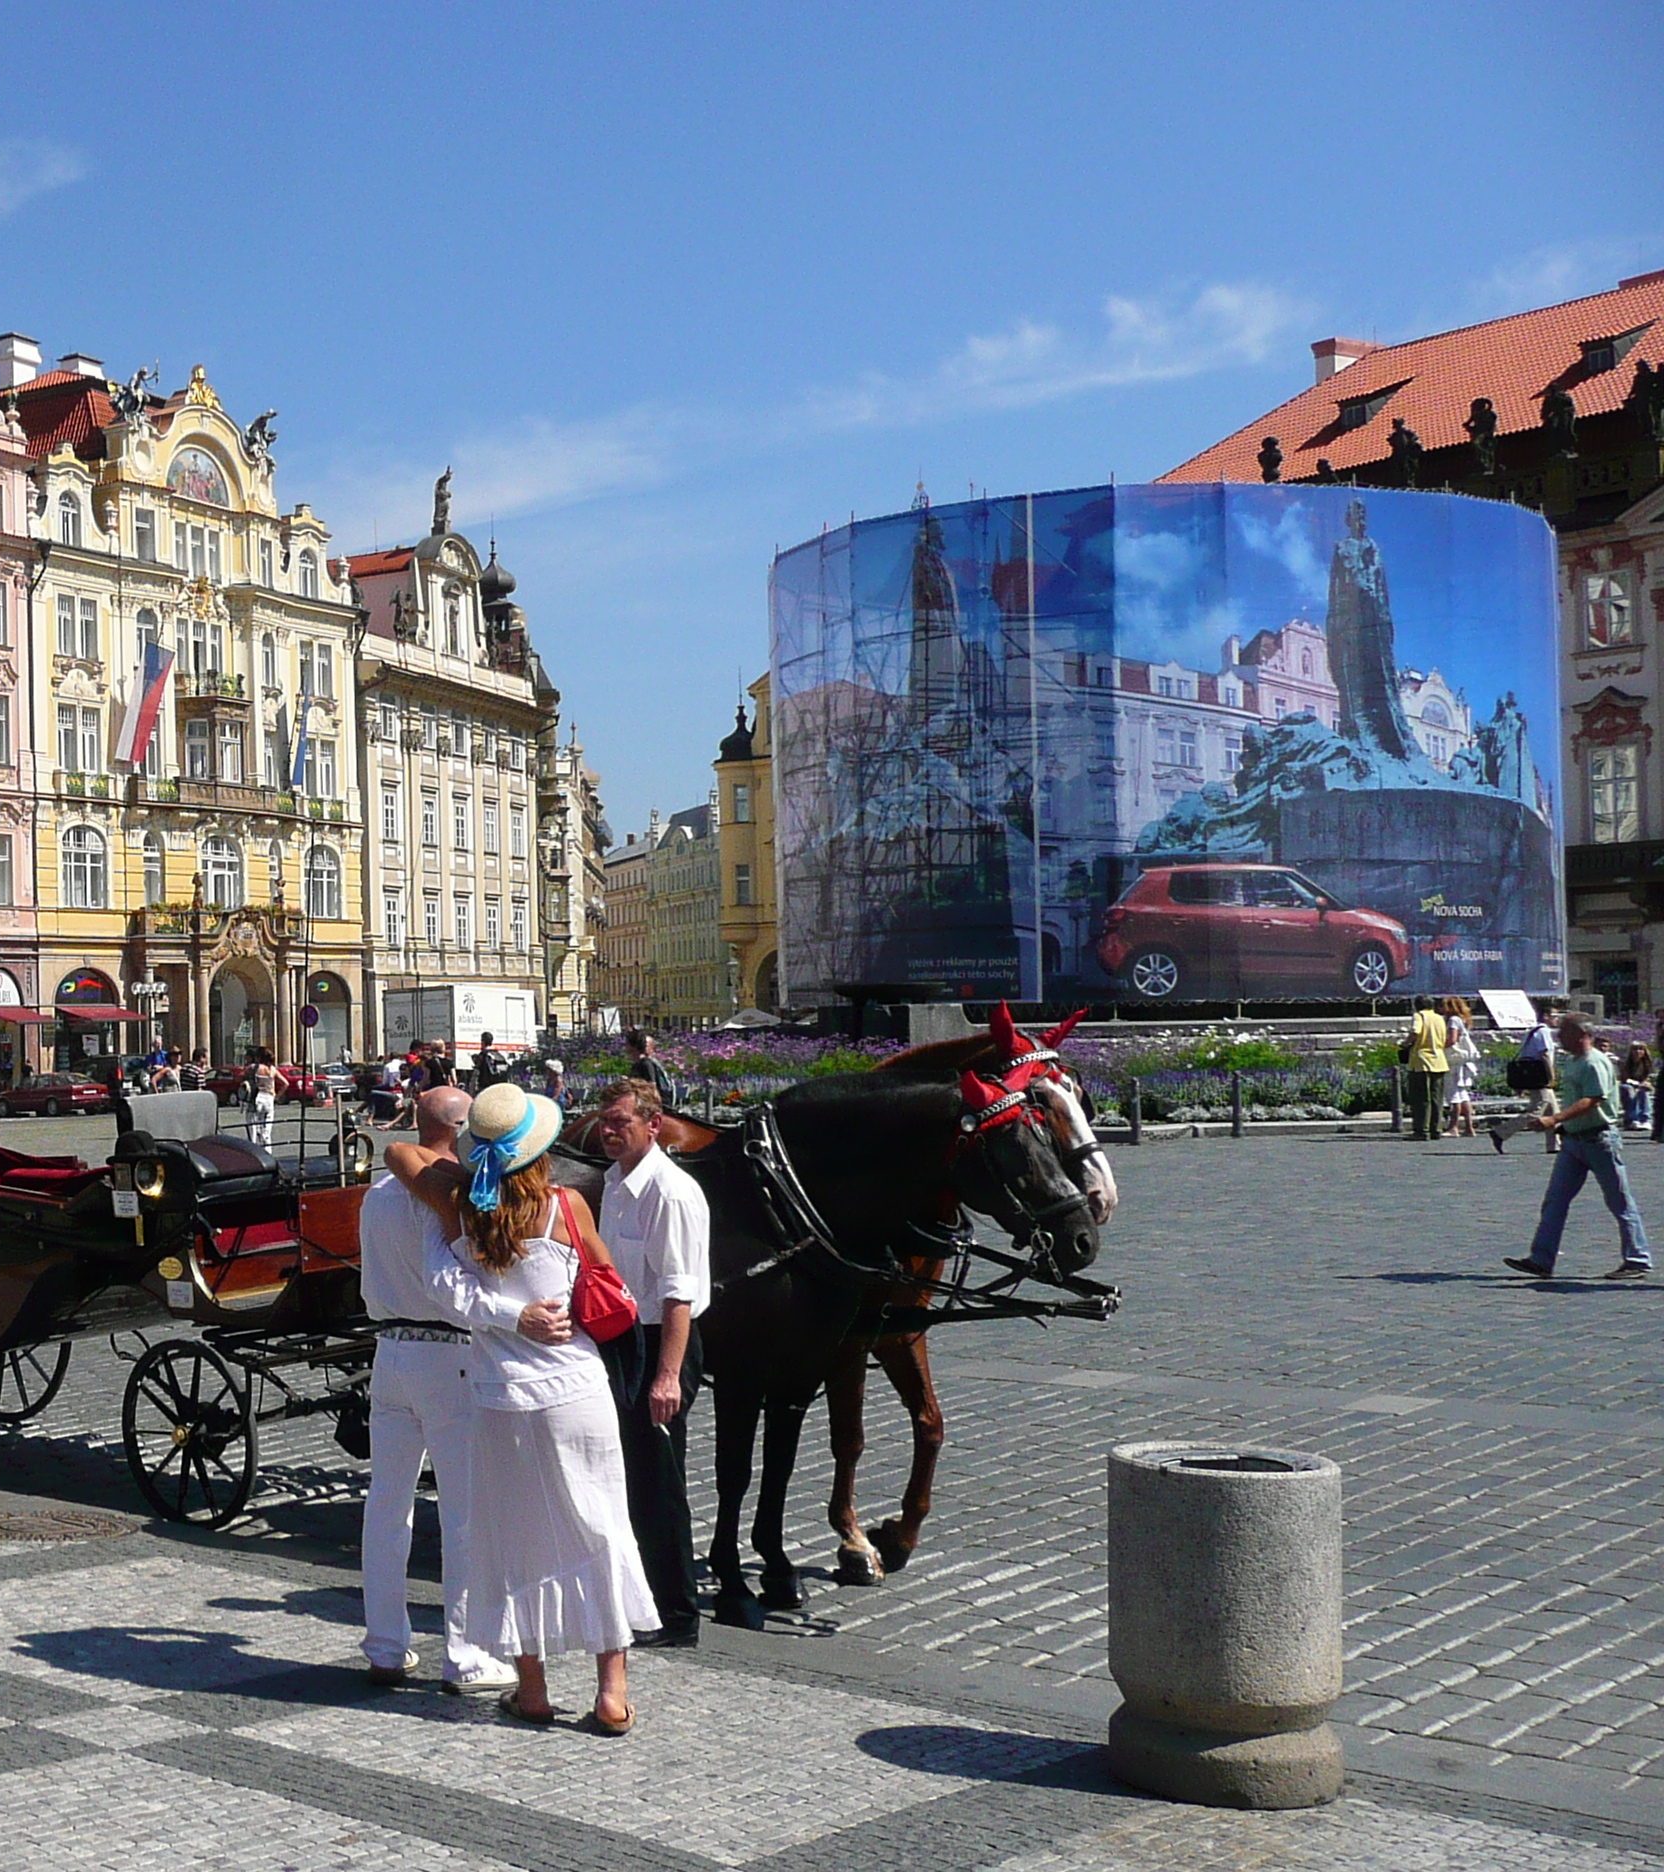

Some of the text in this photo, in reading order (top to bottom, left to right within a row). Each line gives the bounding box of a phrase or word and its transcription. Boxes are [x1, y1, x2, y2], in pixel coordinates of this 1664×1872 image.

[1458, 905, 1483, 917] SOCHA
[942, 956, 976, 968] reklamy
[978, 957, 987, 968] je
[987, 968, 1015, 981] sochy
[458, 1014, 483, 1024] abasto
